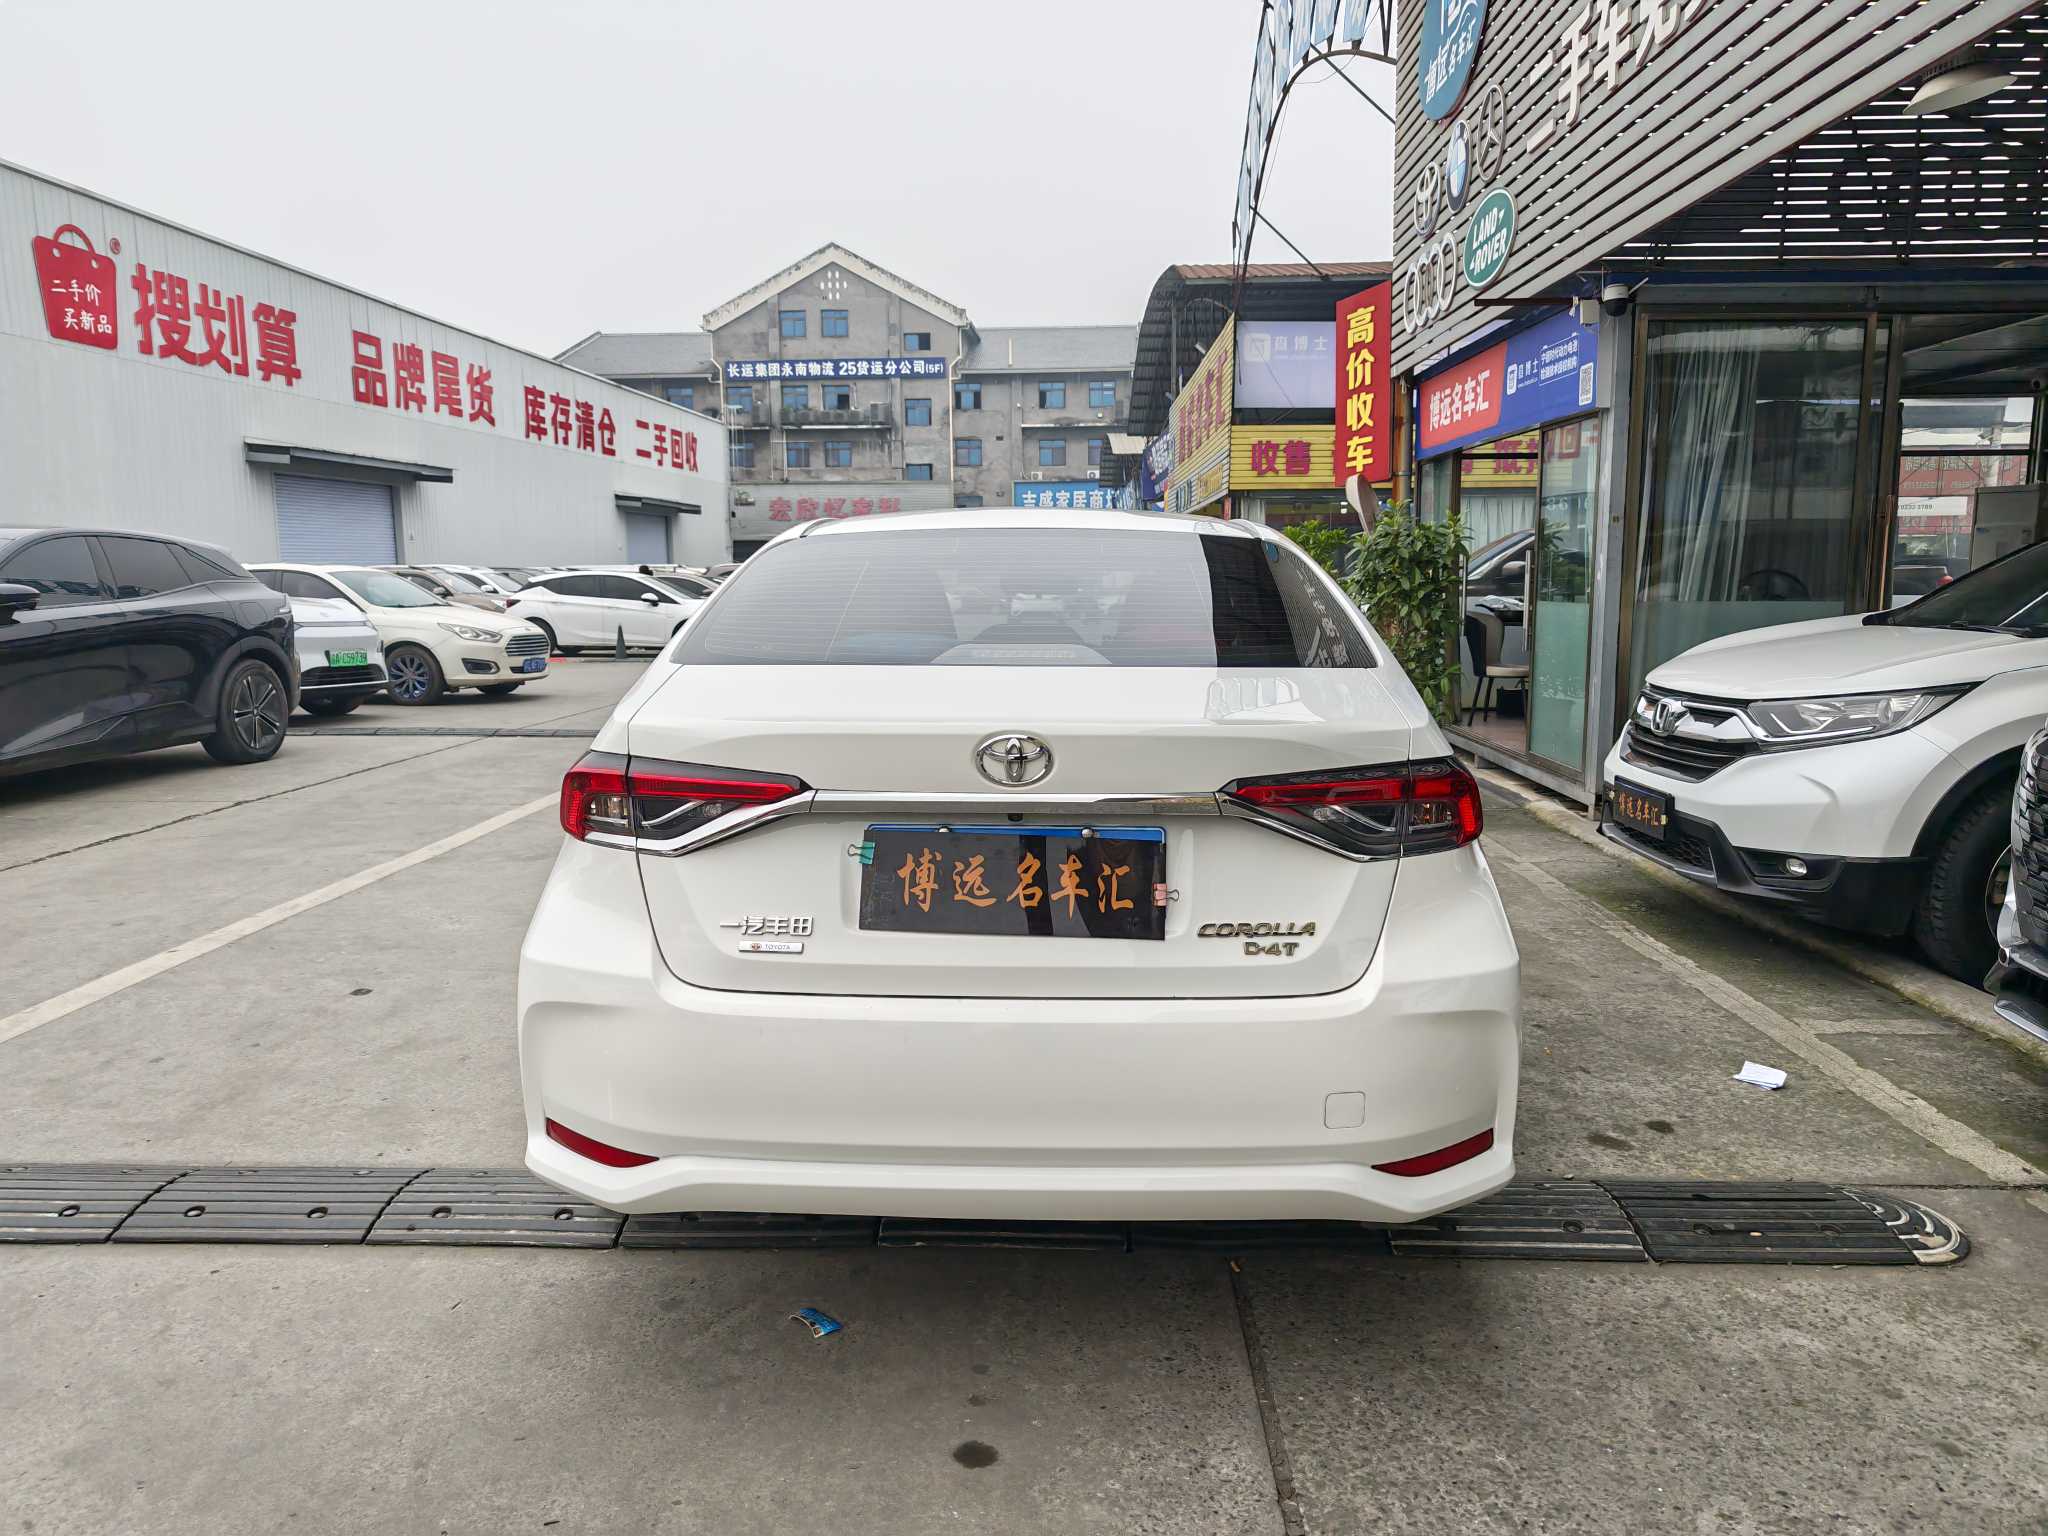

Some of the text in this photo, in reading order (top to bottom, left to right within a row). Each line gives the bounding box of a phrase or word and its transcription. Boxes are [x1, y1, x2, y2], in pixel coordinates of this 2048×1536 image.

[1472, 207, 1498, 250] LAND
[1473, 227, 1507, 276] ROVER
[51, 279, 102, 306] 二手价
[63, 307, 113, 334] 买新品
[131, 262, 699, 473] 搜划算 品牌尾货 库存清仓 二手回收
[1346, 305, 1375, 474] 高价收车
[1429, 369, 1490, 432] 博远名车汇
[1251, 439, 1311, 476] 收售
[896, 848, 1134, 920] 博远名车汇
[719, 915, 813, 936] 一汽丰田
[1197, 922, 1316, 938] COROLLA
